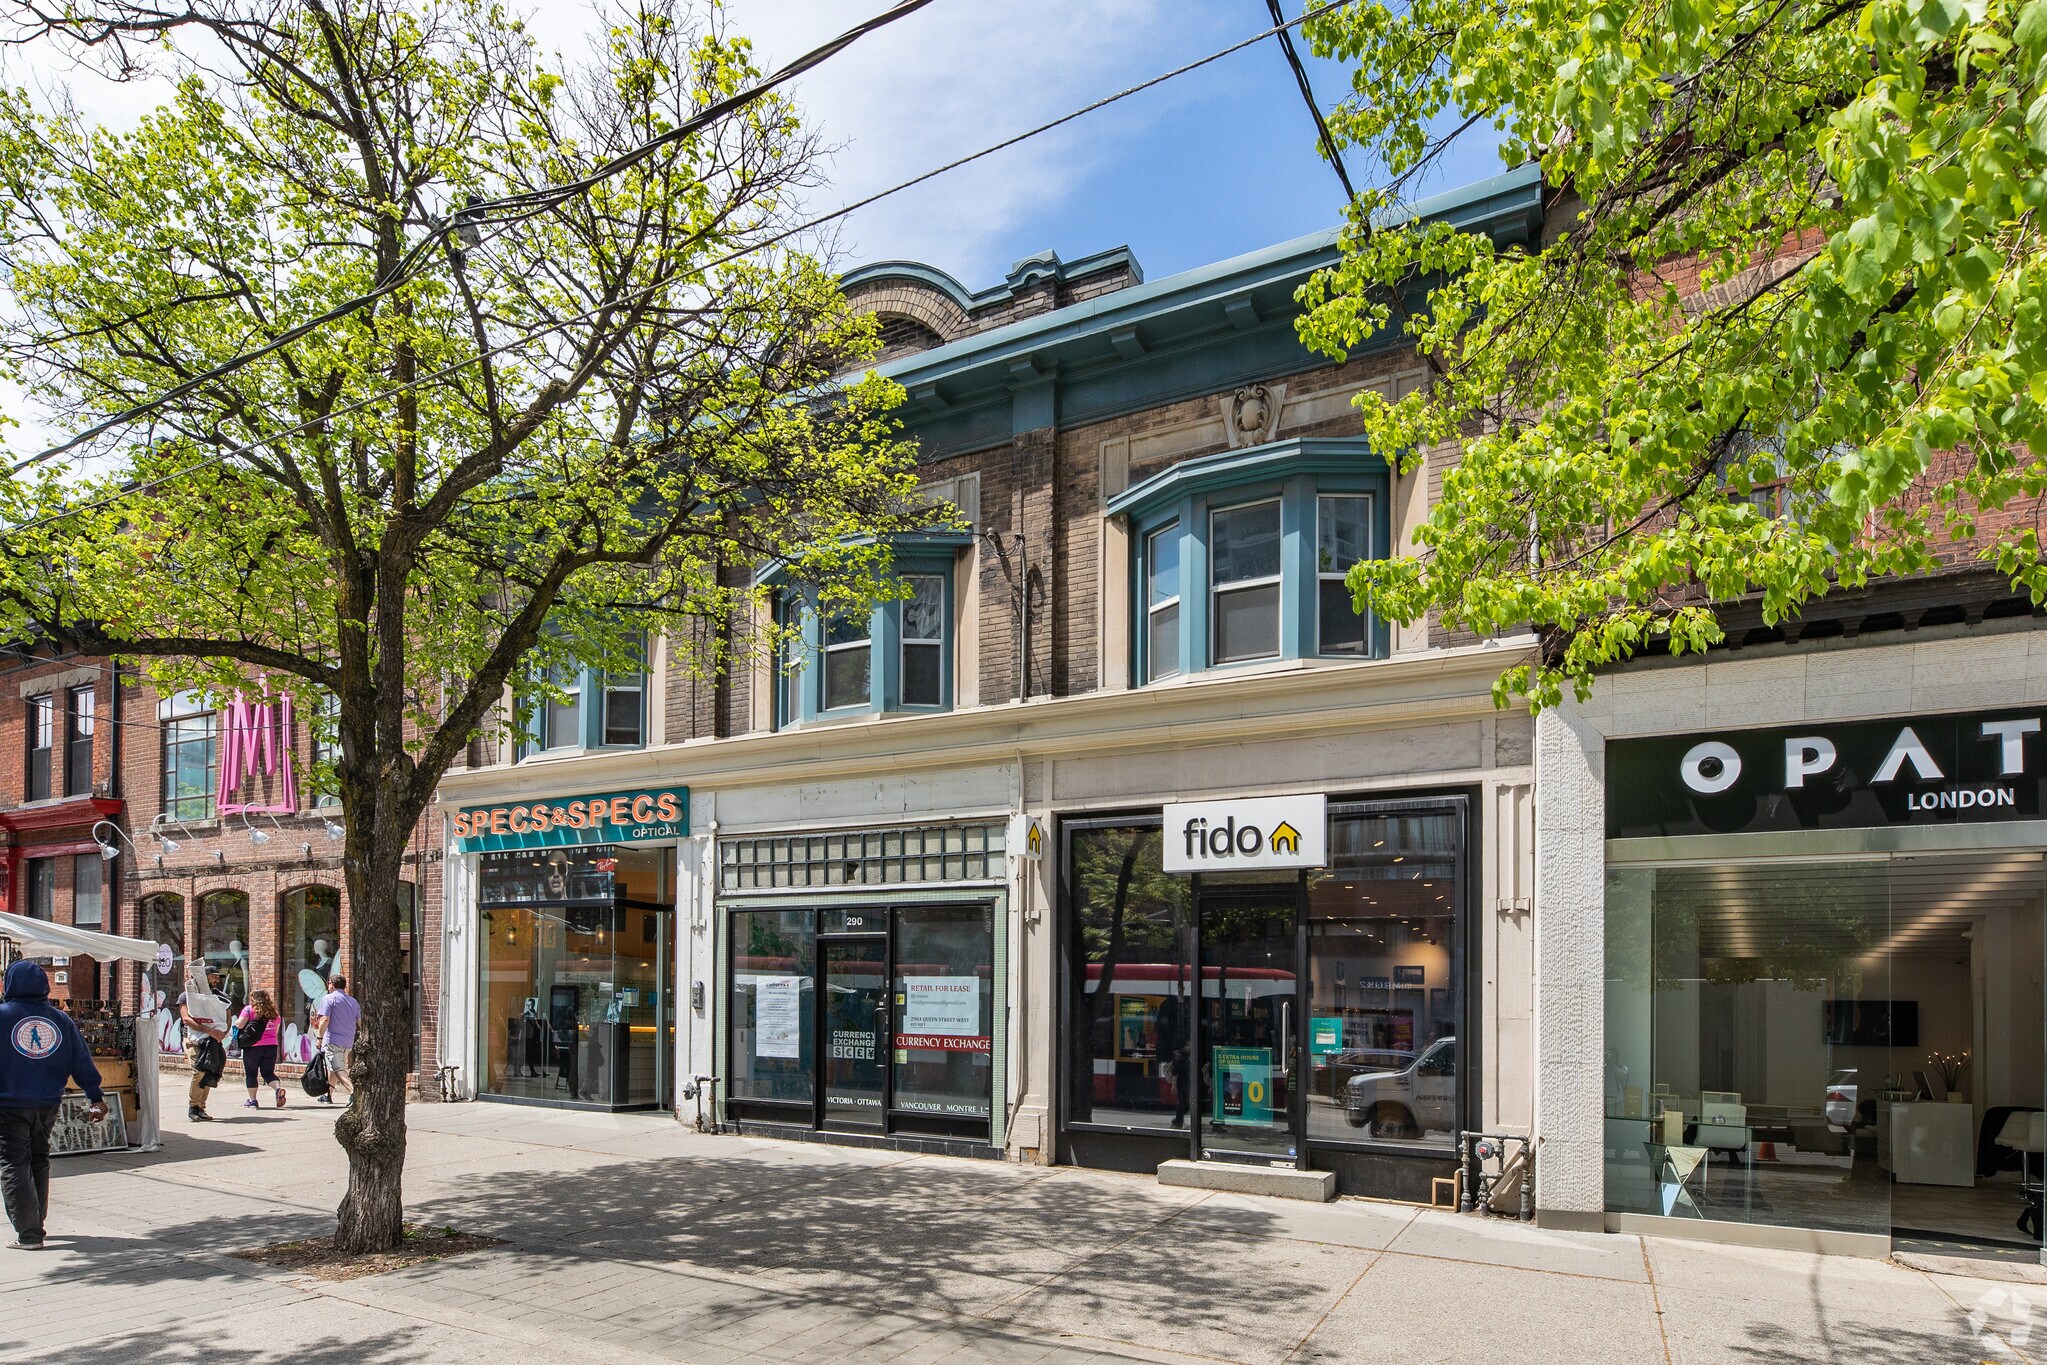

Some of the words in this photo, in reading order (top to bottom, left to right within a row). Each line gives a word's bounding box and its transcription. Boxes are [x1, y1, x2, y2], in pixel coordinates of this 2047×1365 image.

[1908, 787, 2014, 811] LONDON
[632, 826, 680, 838] OPTICAL
[1183, 816, 1263, 859] fido
[846, 917, 863, 926] 290
[950, 985, 971, 993] LEASE
[833, 1030, 875, 1039] CURRENCY
[833, 1038, 875, 1047] EXCHANGE
[896, 1036, 941, 1047] CURRENCY
[943, 1038, 990, 1050] EXCHANGE
[826, 1096, 853, 1105] VICTORIA
[857, 1098, 882, 1106] OTTAWA
[900, 1101, 941, 1111] VANCOUVER
